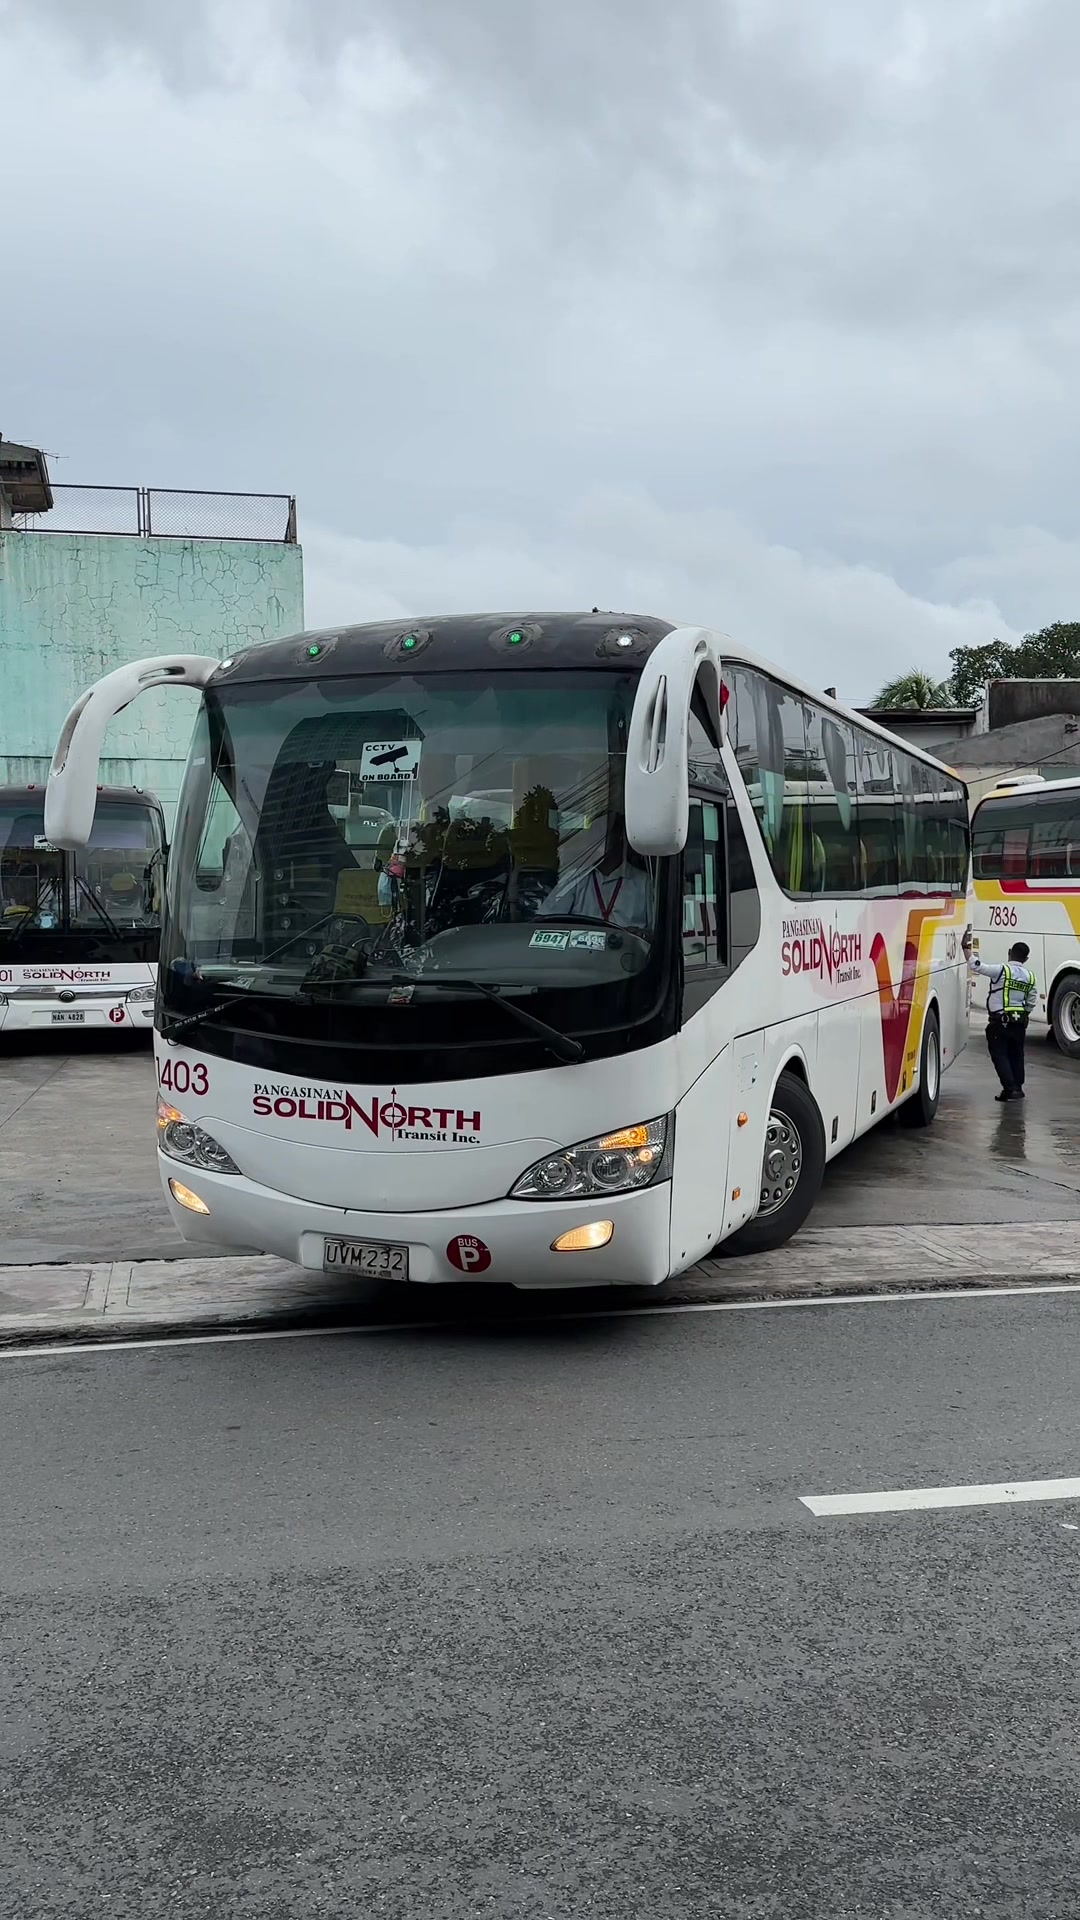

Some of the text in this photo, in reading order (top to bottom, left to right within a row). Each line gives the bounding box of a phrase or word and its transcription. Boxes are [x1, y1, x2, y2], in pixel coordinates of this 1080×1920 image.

[989, 906, 1017, 926] 7836
[782, 918, 821, 938] PANGASINAN
[534, 933, 565, 944] 6947
[836, 966, 862, 984] Transit Inc.
[113, 1010, 121, 1022] P
[156, 1056, 209, 1096] 1403
[253, 1083, 343, 1100] PANGASINAN
[395, 1128, 481, 1144] Transit Inc.
[458, 1238, 479, 1247] BUS
[326, 1244, 403, 1271] UVM 232
[459, 1247, 480, 1271] P
